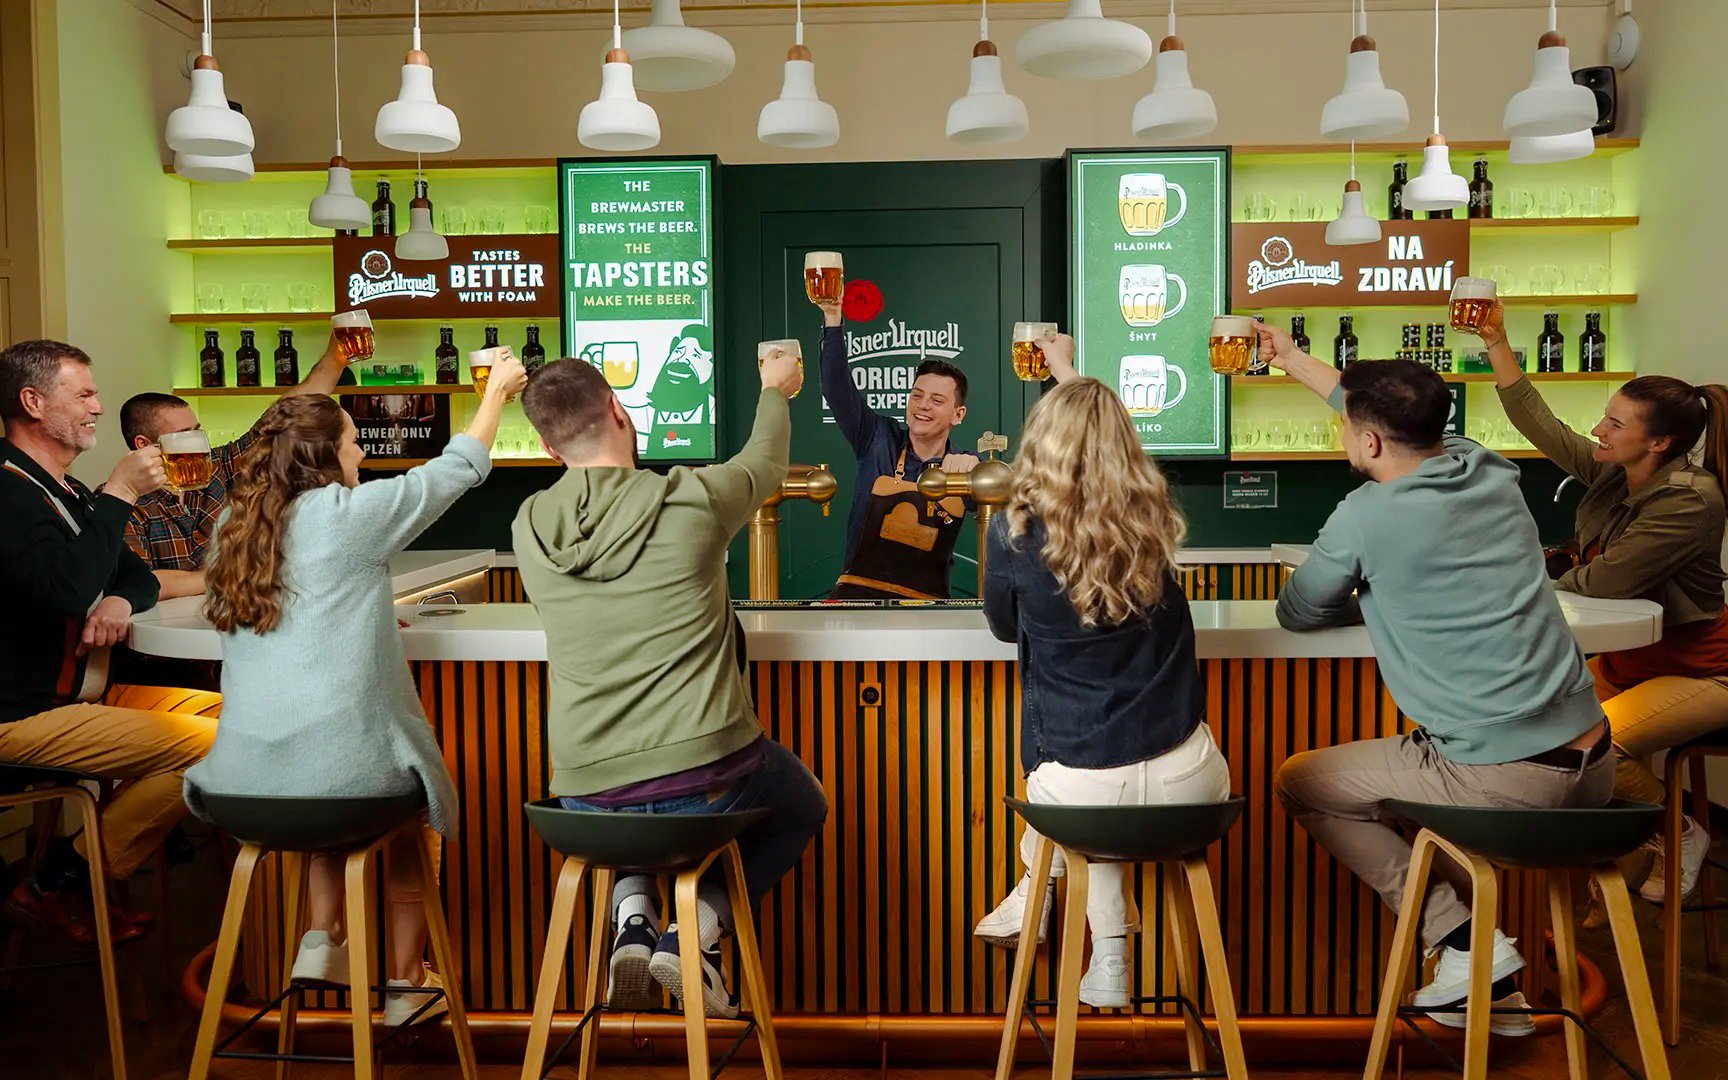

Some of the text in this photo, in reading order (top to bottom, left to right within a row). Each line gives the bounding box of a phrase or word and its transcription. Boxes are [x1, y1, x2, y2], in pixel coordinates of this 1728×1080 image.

[623, 181, 651, 192] THE
[591, 201, 685, 213] BREWMASTER
[579, 221, 698, 234] BREWS THE BEER.
[625, 243, 652, 254] THE
[1114, 242, 1173, 251] HLADINKA
[1388, 235, 1424, 260] NA
[472, 250, 520, 261] TASTES
[450, 264, 545, 289] BETTER
[569, 260, 708, 288] TAPSTERS
[1247, 258, 1343, 294] Pilsner Urquell
[1357, 260, 1455, 292] ZDRAVÍ
[348, 271, 439, 306] Pilsner Urquell
[458, 291, 537, 303] WITH FOAM
[583, 294, 695, 306] MAKE THE BEER.
[888, 318, 960, 360] Urquell
[1129, 331, 1157, 341] ŠNYT
[851, 366, 918, 390] ORIGI
[401, 427, 432, 438] ONLY
[1136, 422, 1163, 432] LÍKO
